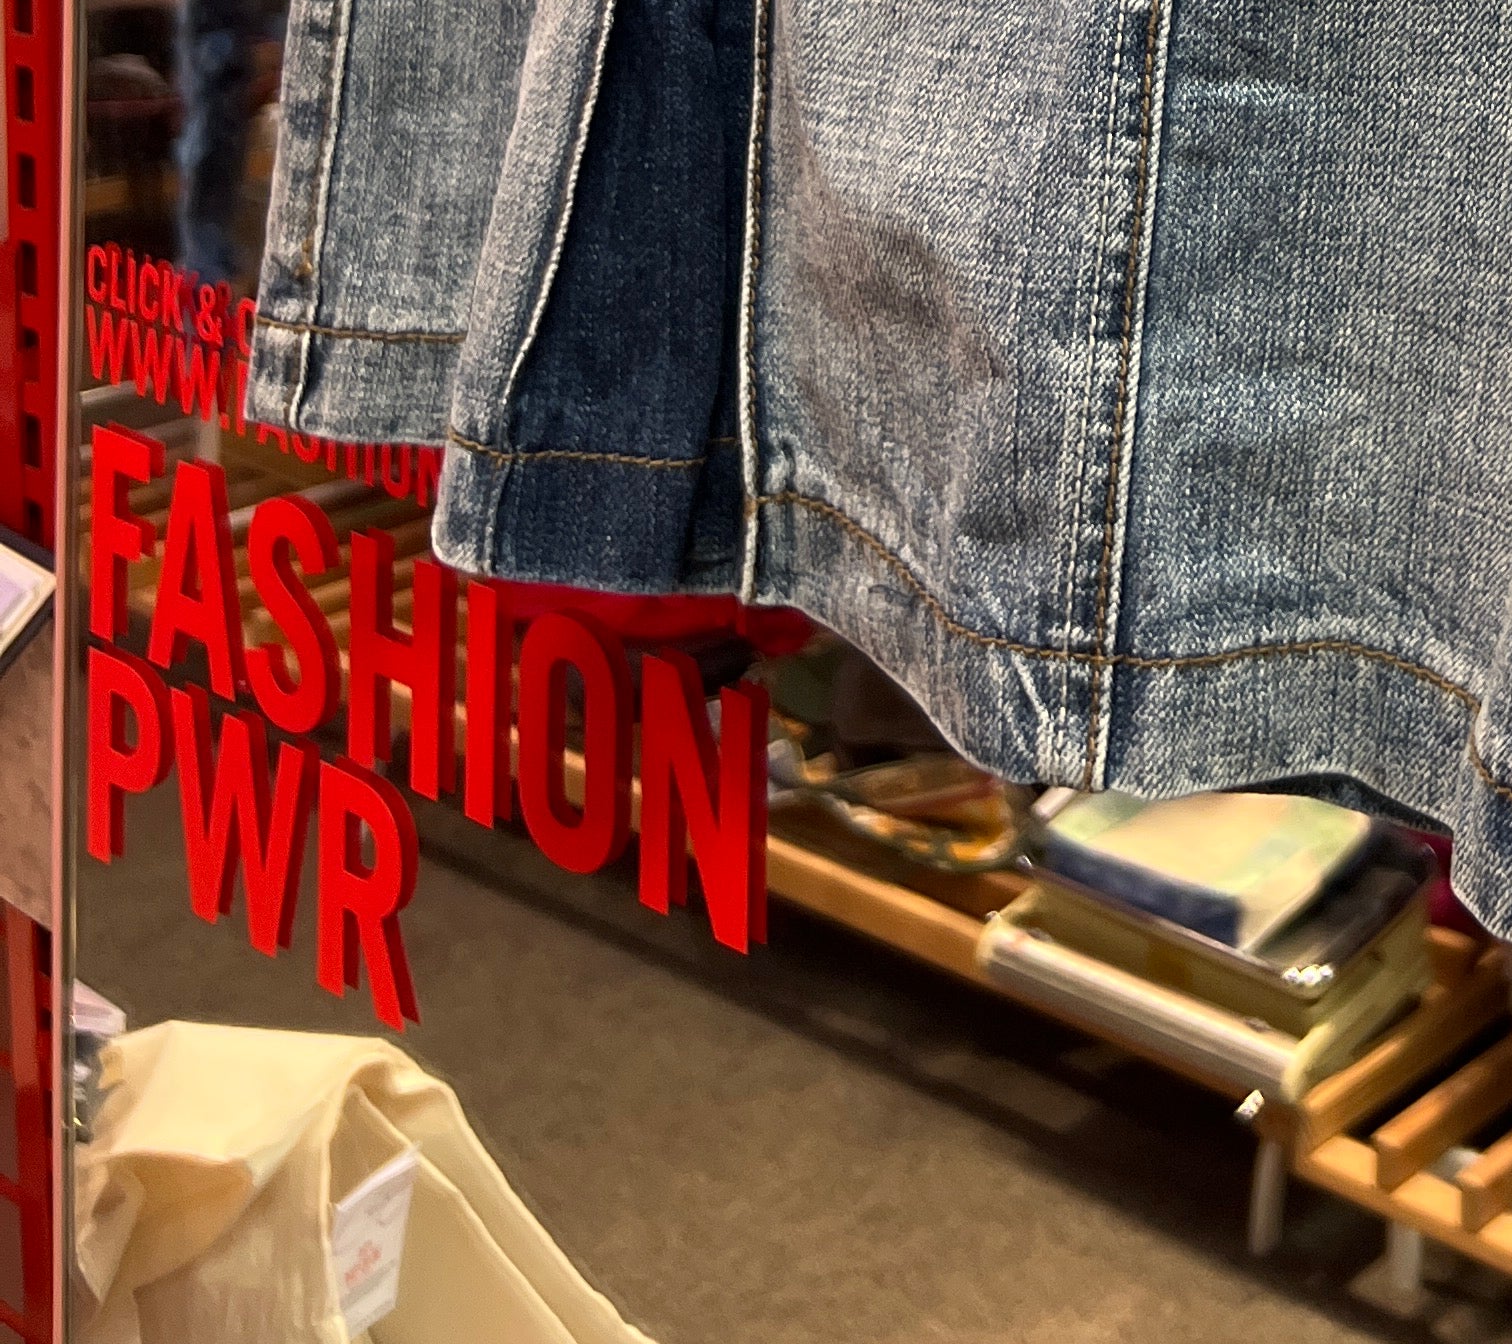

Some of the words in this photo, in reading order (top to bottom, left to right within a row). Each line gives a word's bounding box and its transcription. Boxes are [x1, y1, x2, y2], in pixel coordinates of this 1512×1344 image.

[87, 244, 184, 333] CLICK
[196, 283, 223, 346] &
[87, 646, 406, 1032] PWR
[90, 425, 752, 955] FASHION
